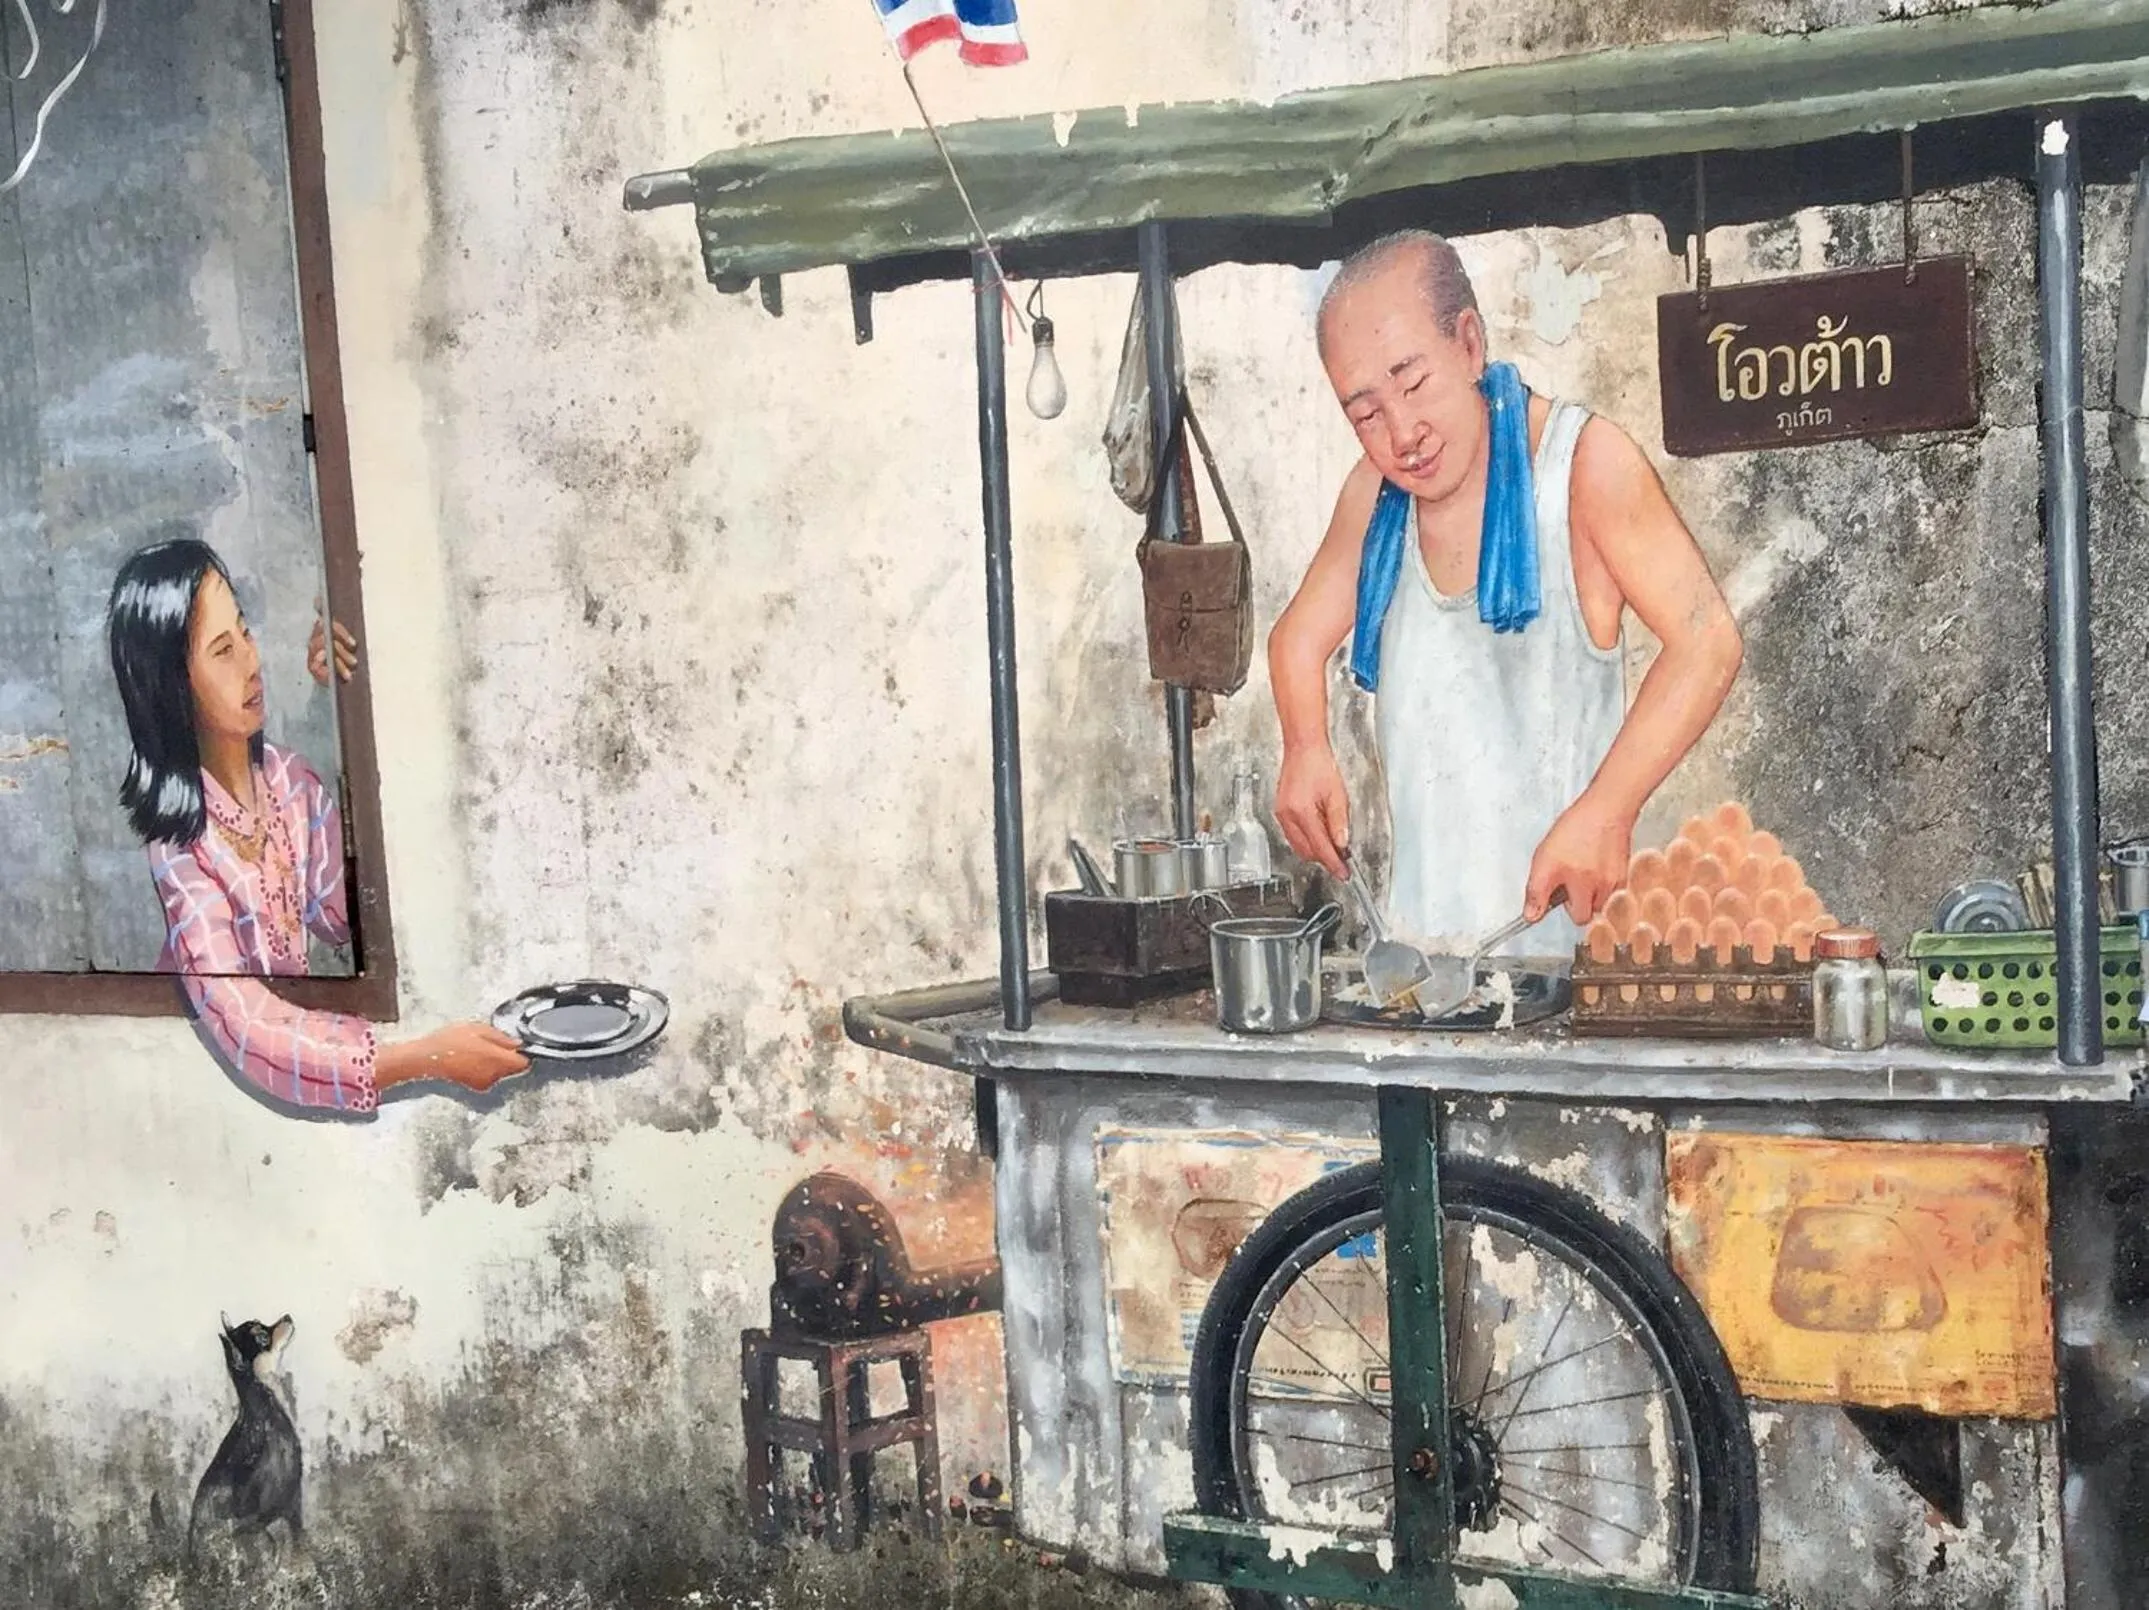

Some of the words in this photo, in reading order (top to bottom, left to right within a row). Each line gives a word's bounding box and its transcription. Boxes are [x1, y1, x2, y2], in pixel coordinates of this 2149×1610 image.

[1707, 315, 1892, 402] โอวต้าว
[1776, 401, 1832, 436] ภูเก็ต
